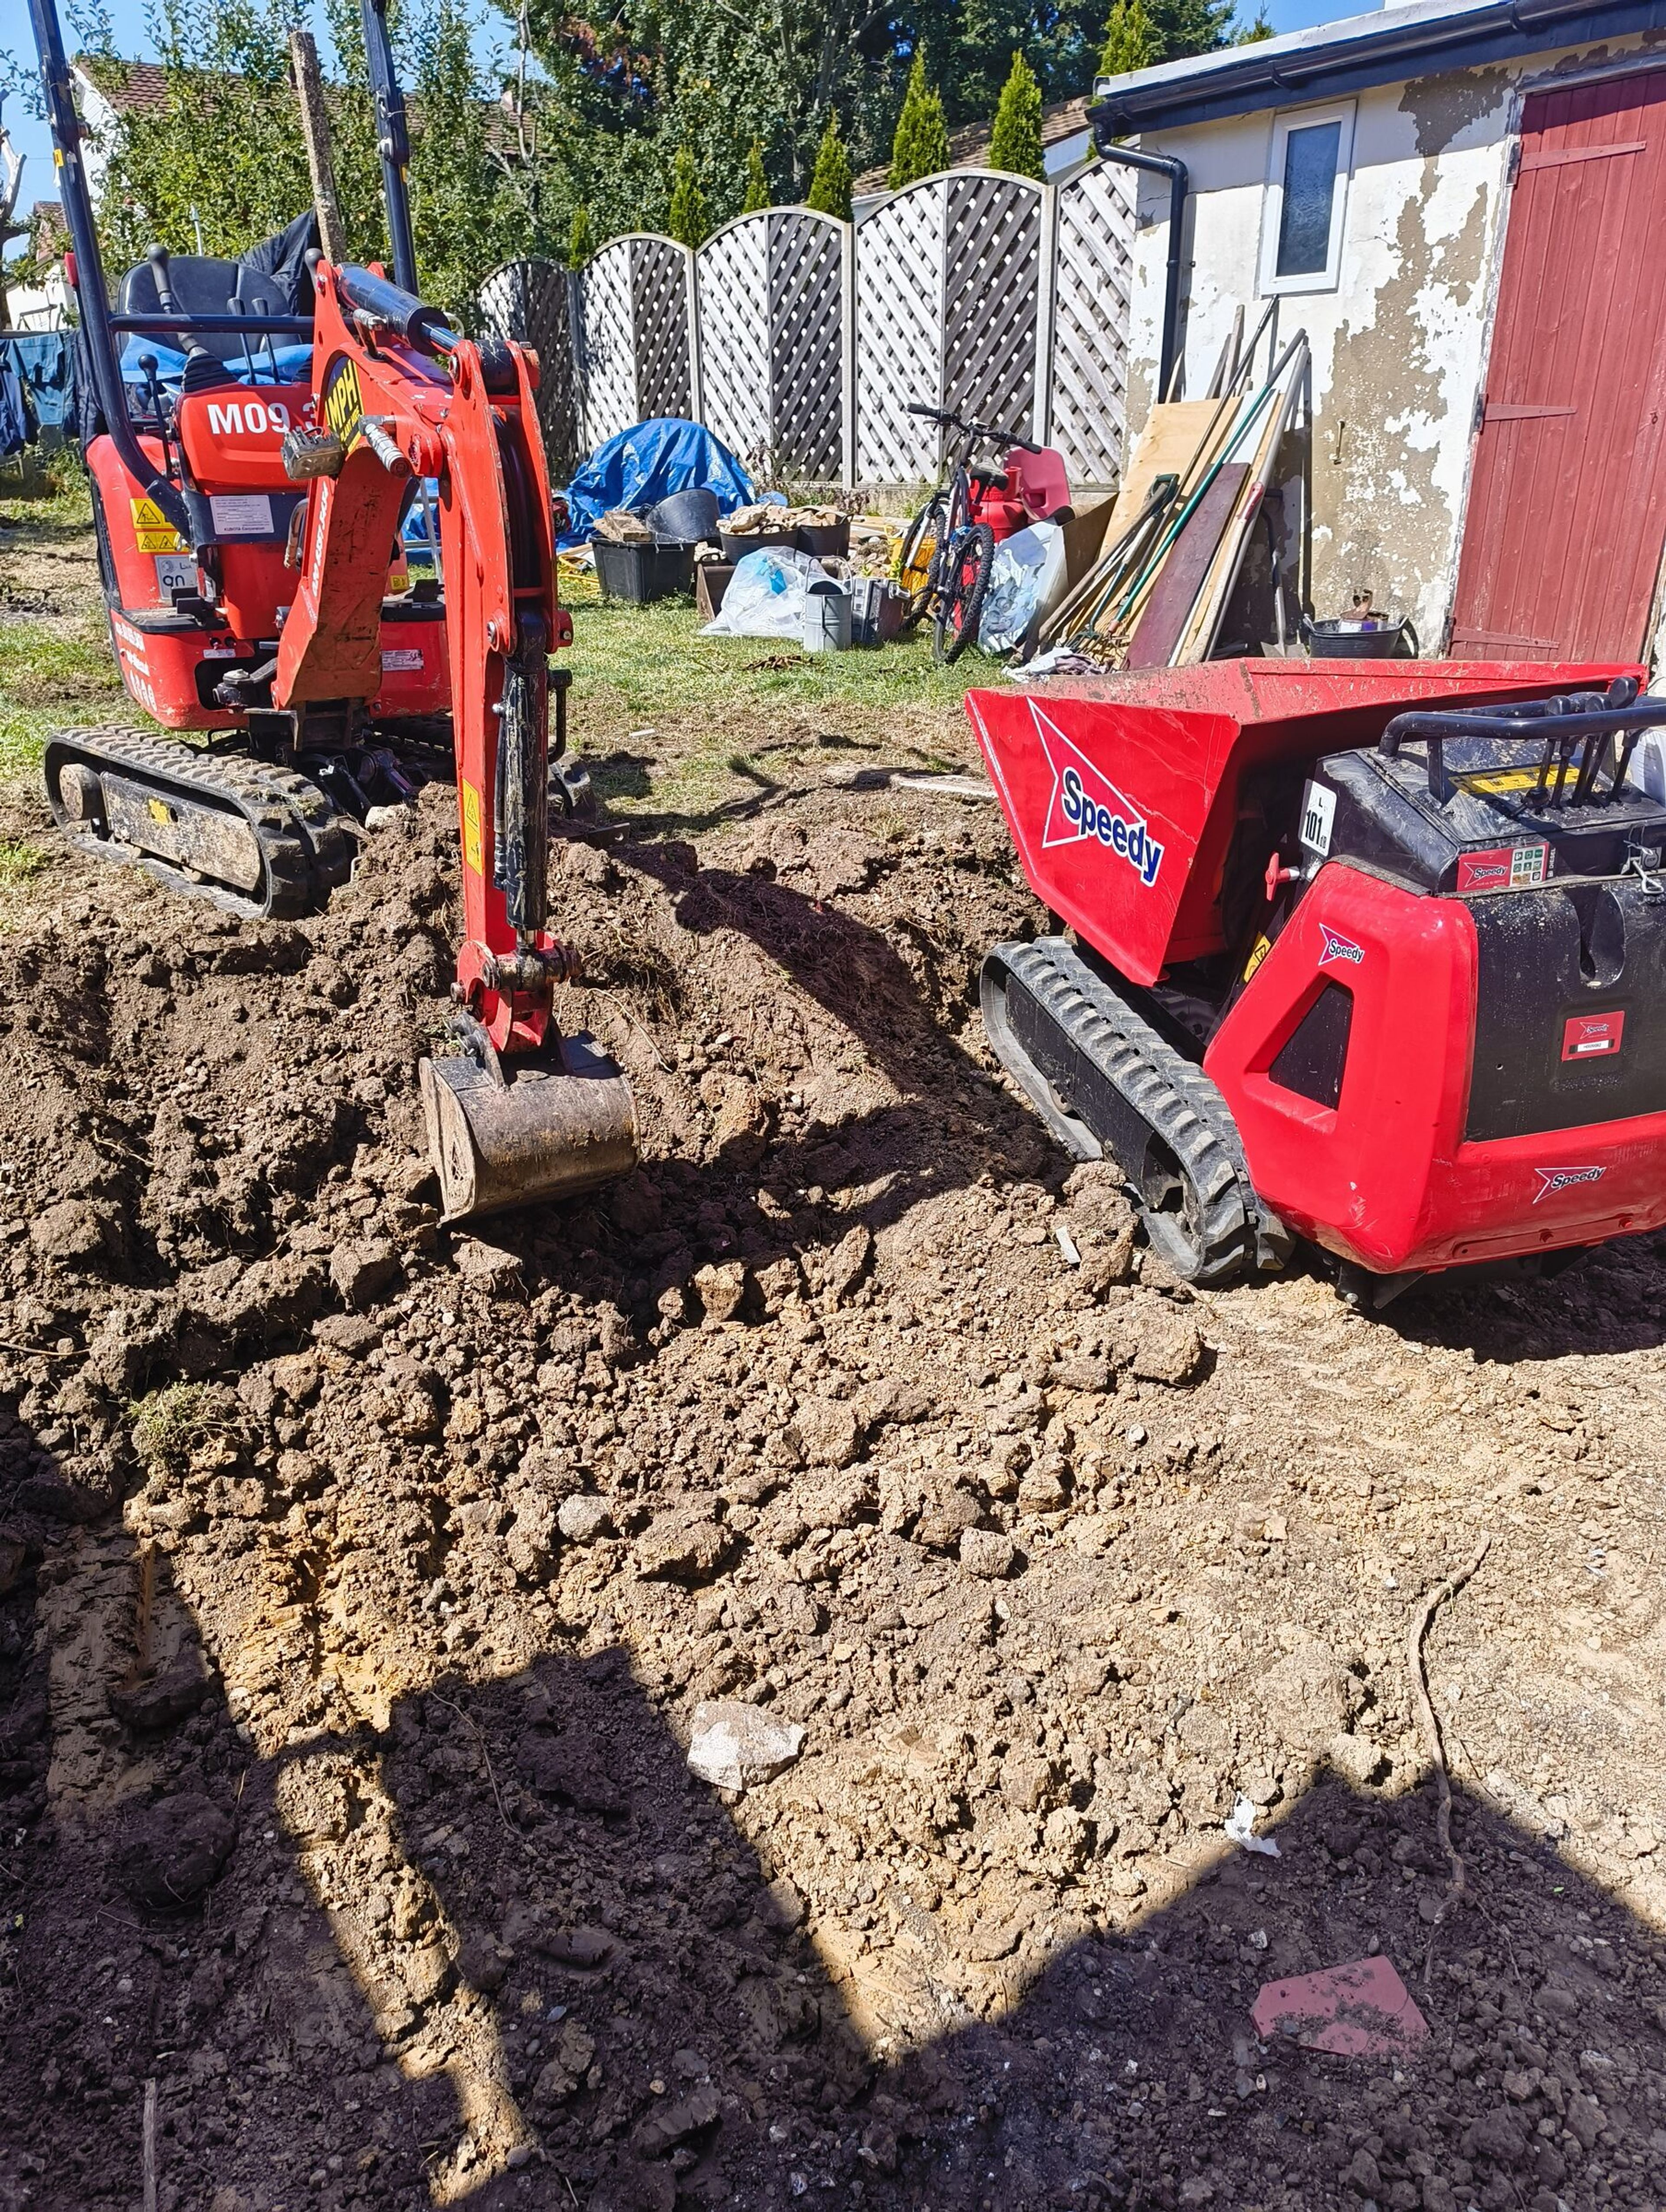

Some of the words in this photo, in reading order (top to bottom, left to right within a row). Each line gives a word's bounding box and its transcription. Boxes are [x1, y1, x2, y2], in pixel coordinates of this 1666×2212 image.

[328, 358, 357, 432] MPH
[1063, 768, 1163, 885] Speedy
[1474, 867, 1506, 878] Speedy
[1329, 939, 1364, 962] Speedy
[1551, 1168, 1605, 1188] Speedy
